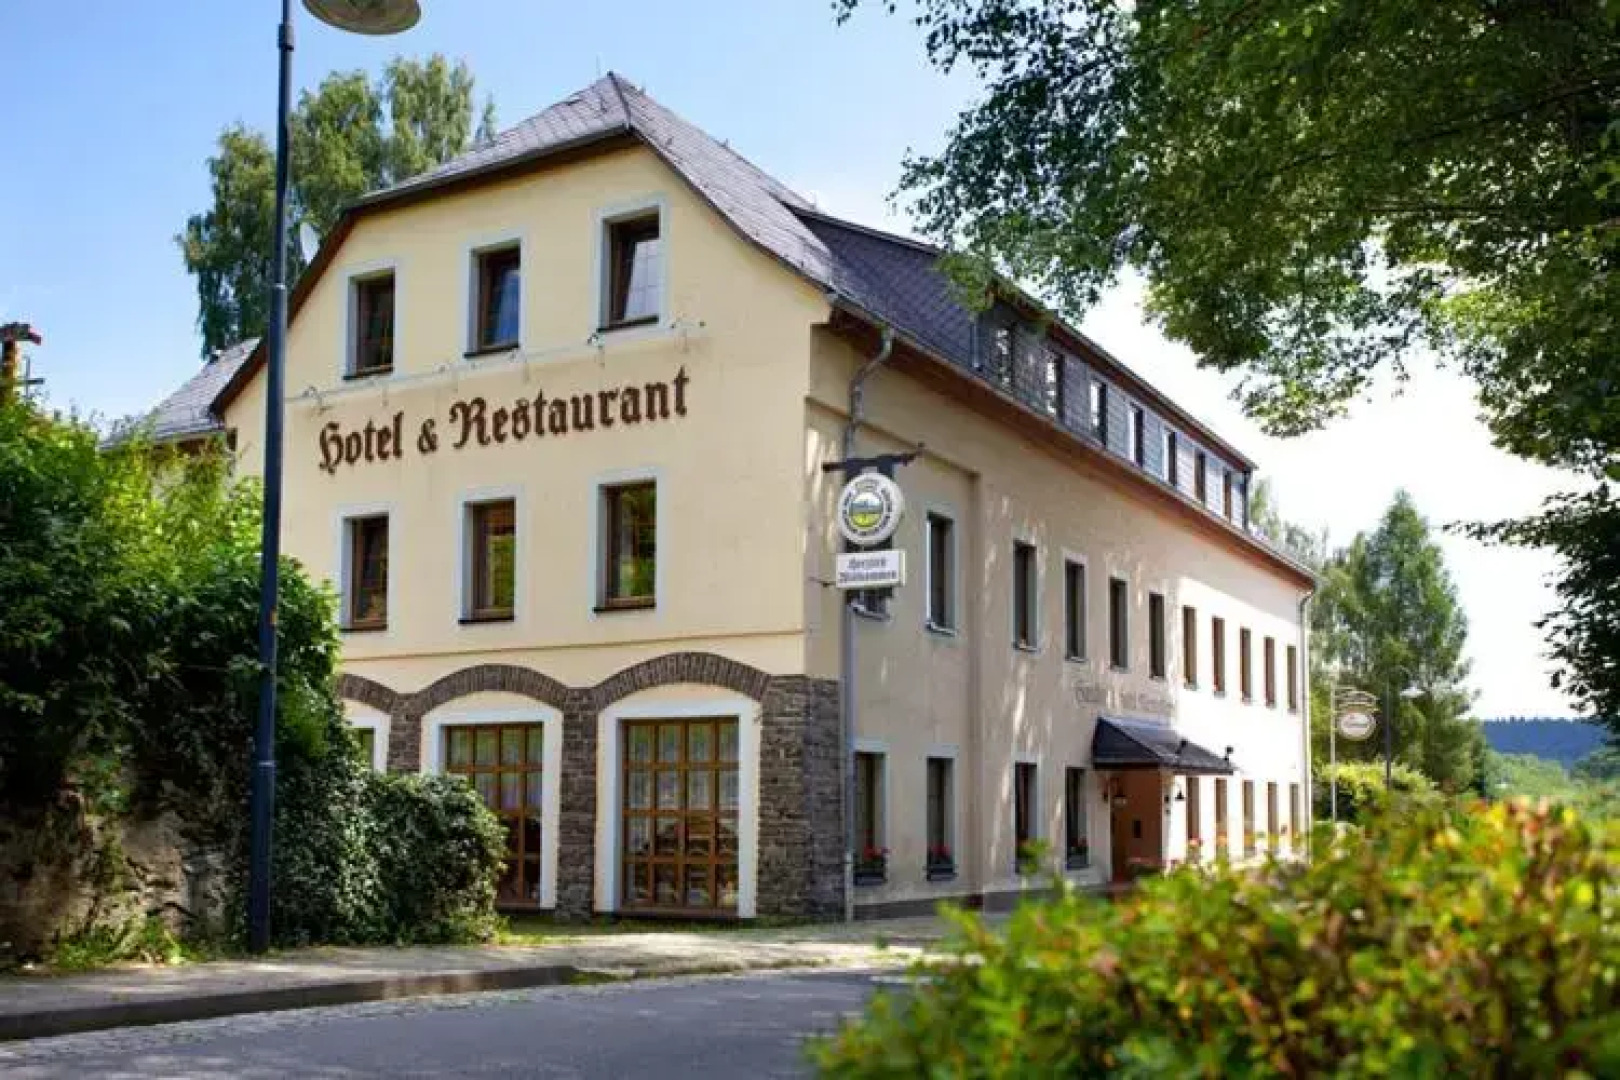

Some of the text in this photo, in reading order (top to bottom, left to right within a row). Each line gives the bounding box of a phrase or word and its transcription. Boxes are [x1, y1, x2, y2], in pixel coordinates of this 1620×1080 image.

[319, 366, 690, 475] Hotel & Restaurant
